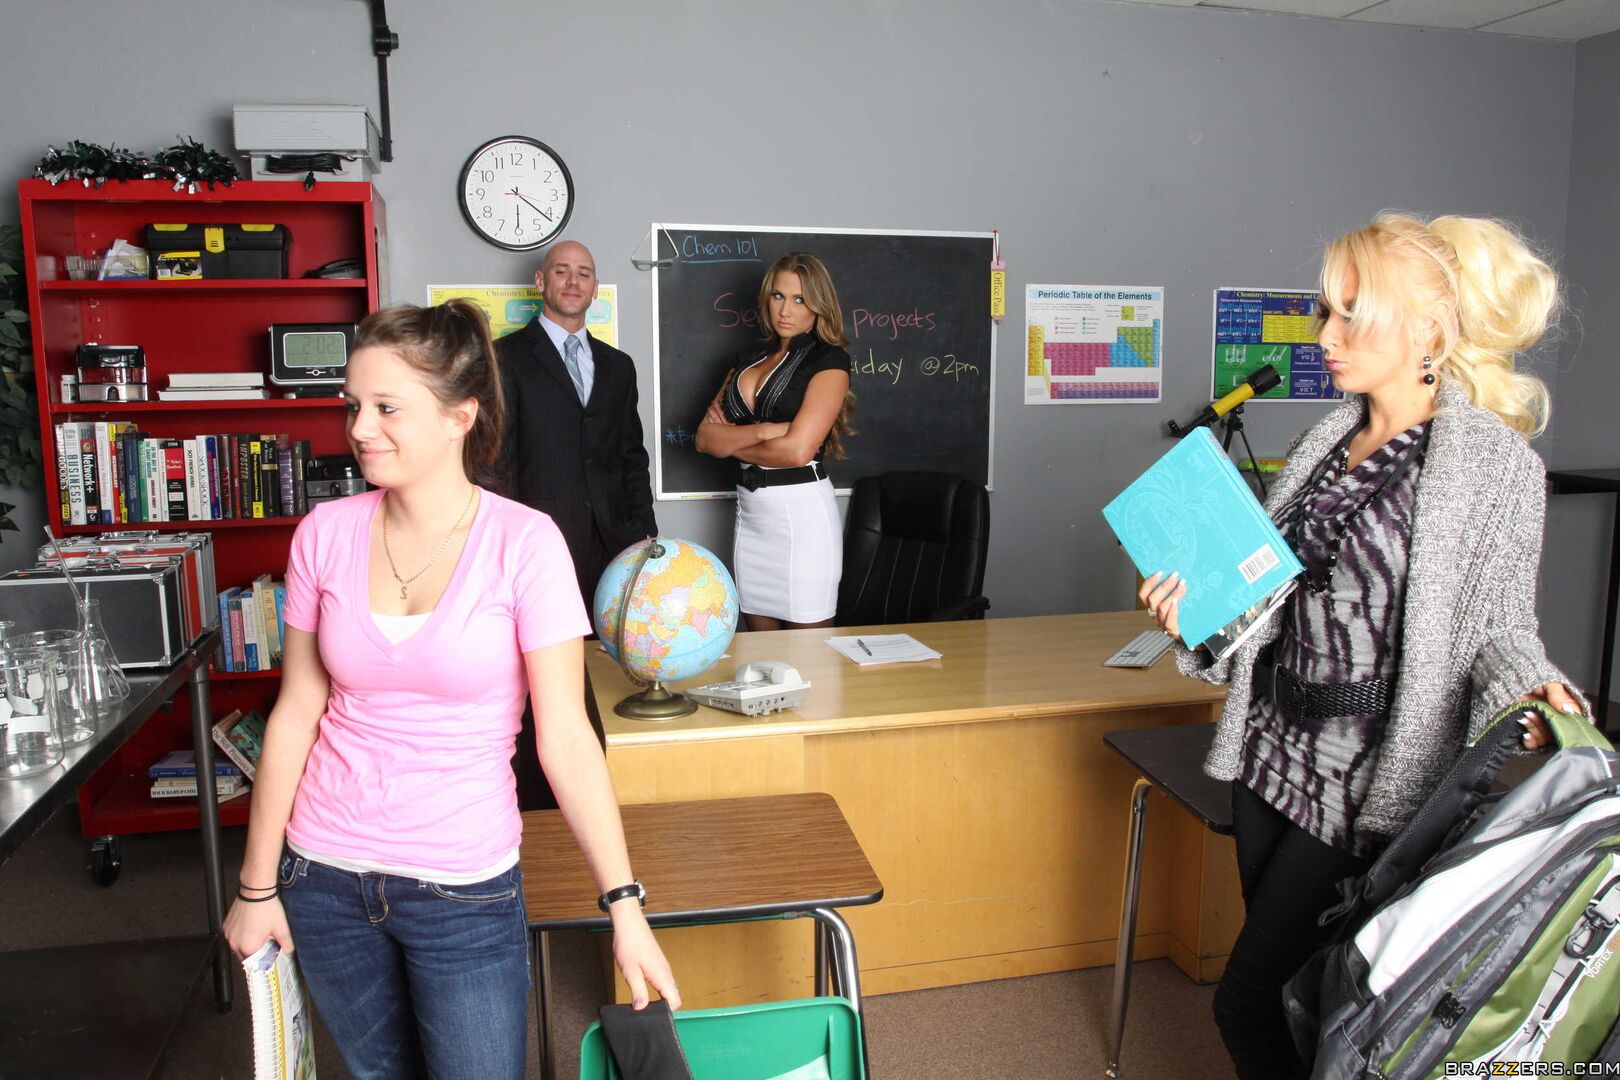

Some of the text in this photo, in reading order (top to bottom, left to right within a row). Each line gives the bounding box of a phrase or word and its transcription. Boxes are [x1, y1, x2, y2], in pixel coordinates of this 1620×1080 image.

[495, 157, 503, 170] 11
[510, 153, 523, 166] 12
[532, 158, 536, 170] 1
[481, 170, 495, 183] 10
[543, 170, 552, 183] 2
[476, 188, 486, 201] 9
[550, 189, 559, 201] 3
[483, 205, 493, 219] 8
[545, 206, 553, 219] 4
[496, 219, 505, 231] 7
[514, 226, 524, 236] 6
[532, 218, 542, 231] 5
[682, 235, 732, 257] Chem
[486, 290, 544, 298] Chemistry: Bas
[993, 272, 1003, 314] Office Pass
[1038, 290, 1152, 300] Periodic Table of the Elements
[1236, 291, 1266, 299] Chemistry:
[850, 348, 903, 385] iday
[240, 443, 249, 480] IMPOSTER
[67, 454, 82, 504] BUSINESS
[82, 454, 96, 494] Network+
[1586, 948, 1614, 979] VORTEX
